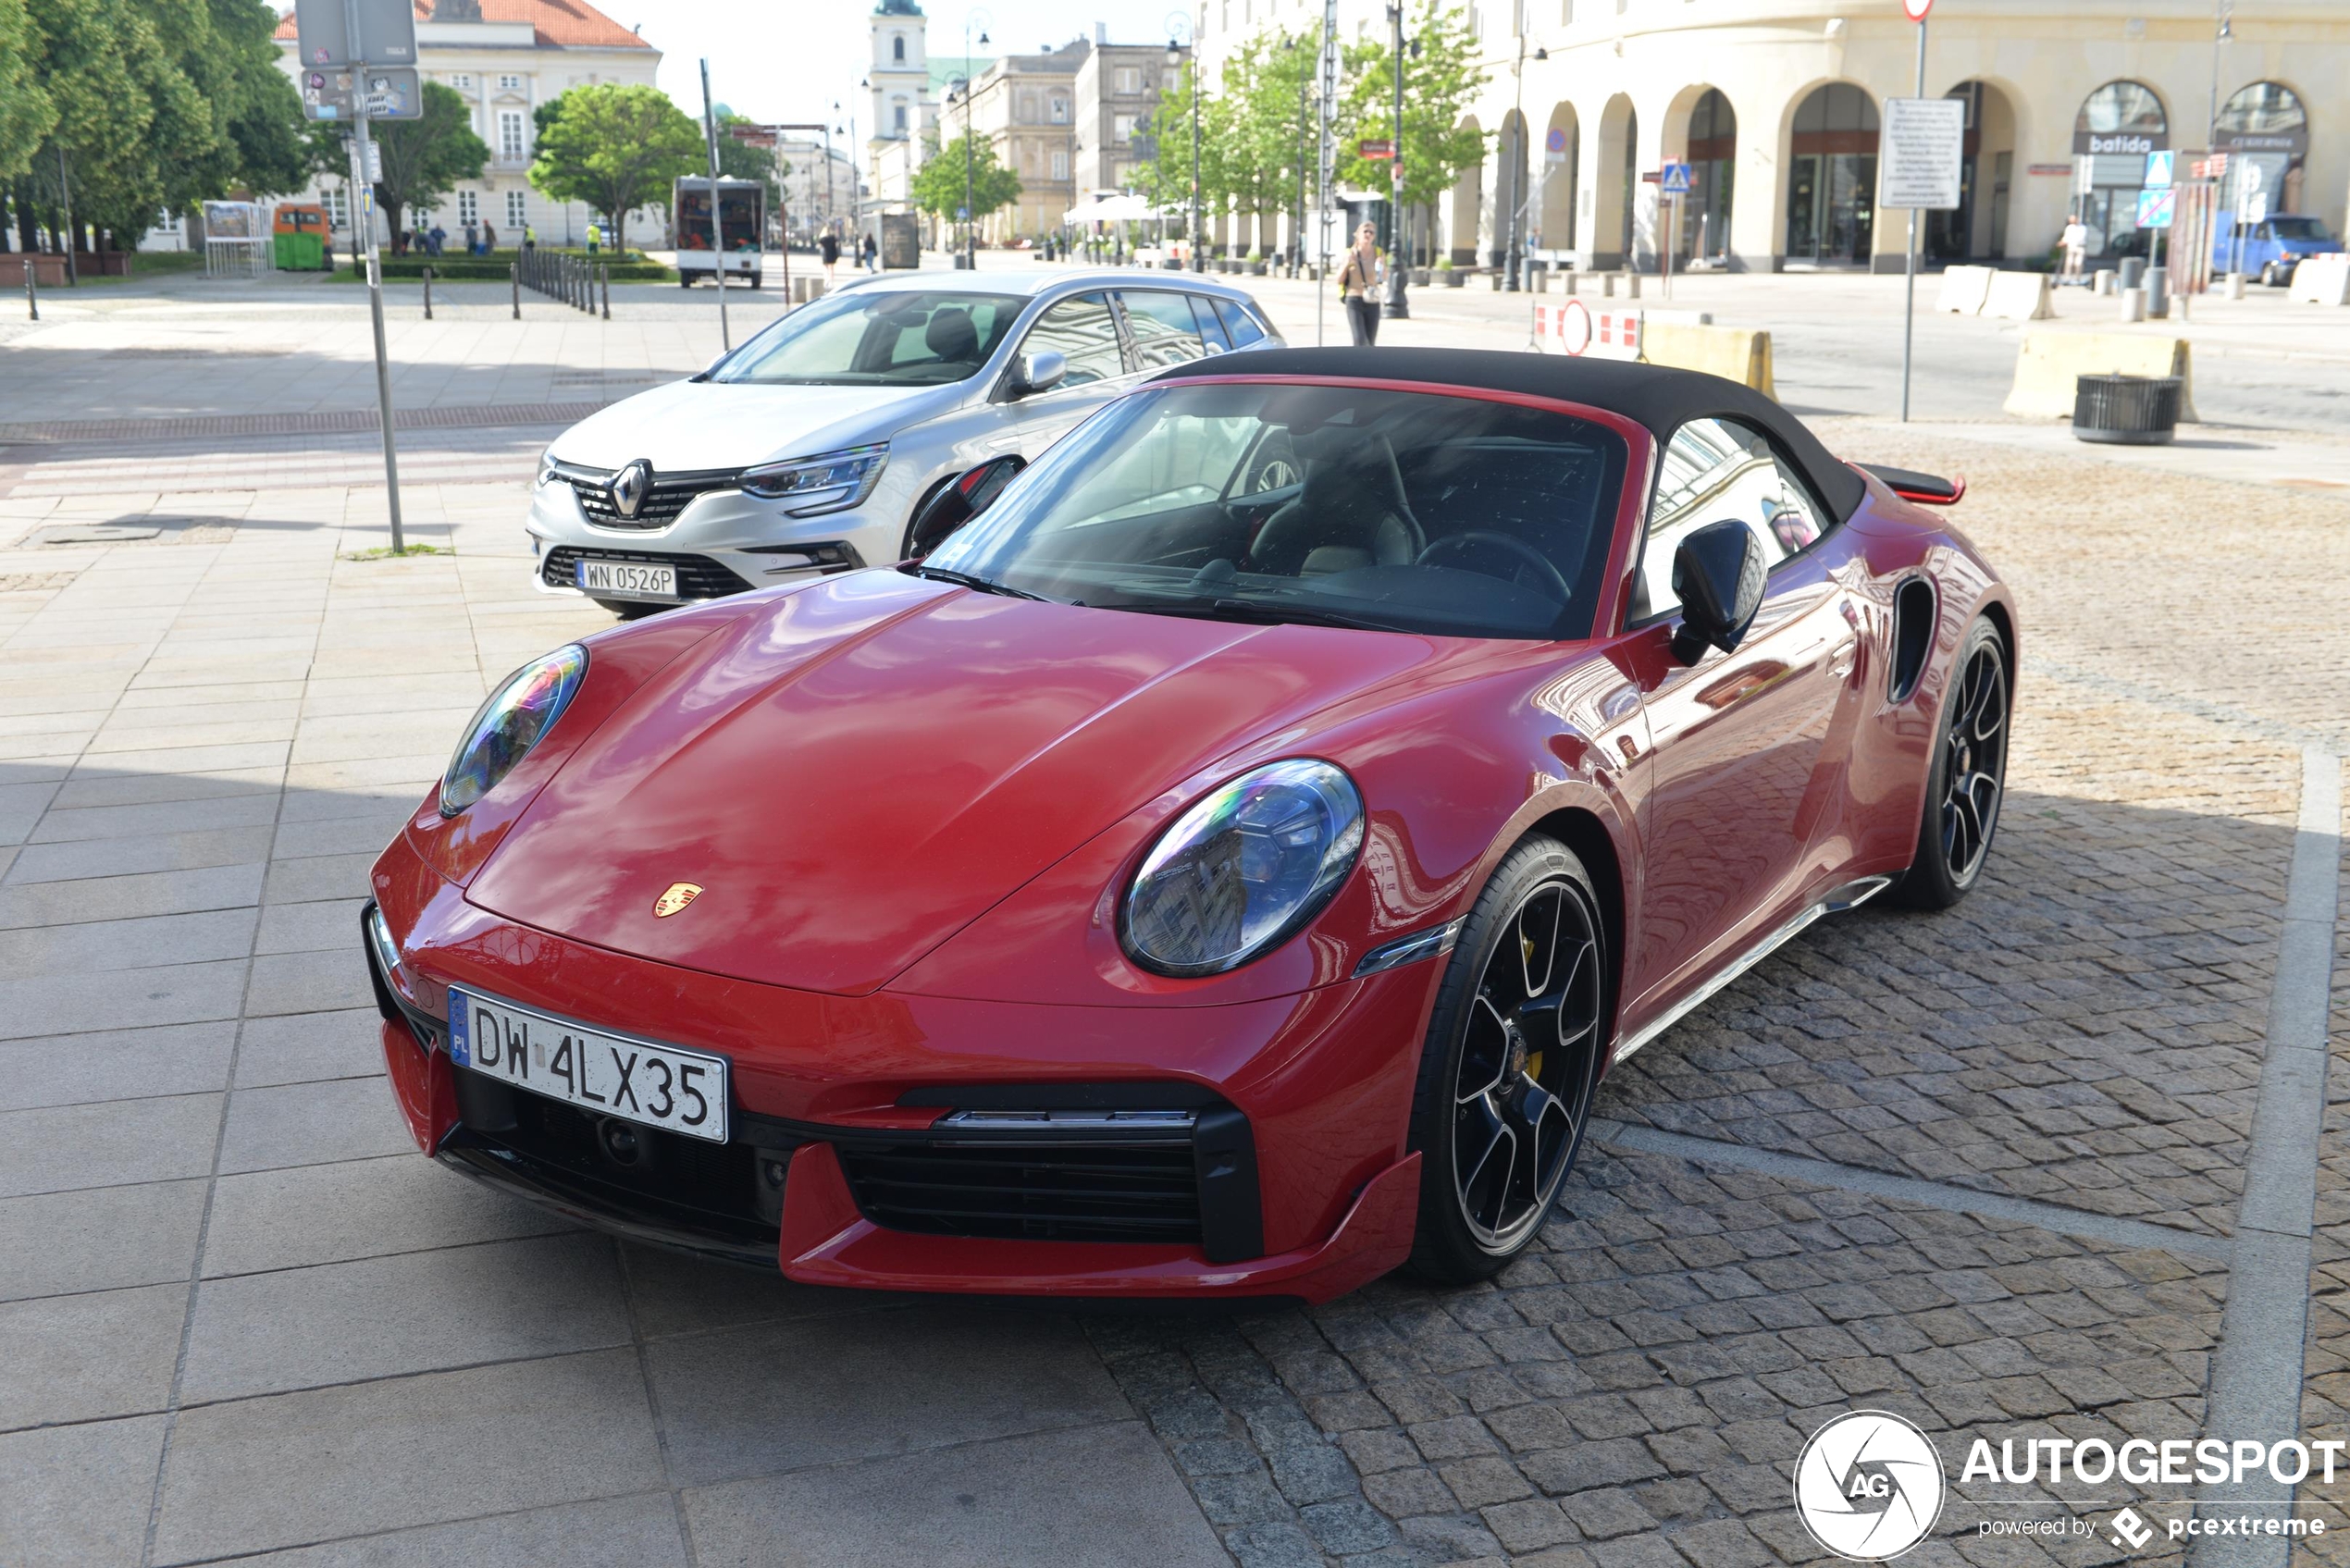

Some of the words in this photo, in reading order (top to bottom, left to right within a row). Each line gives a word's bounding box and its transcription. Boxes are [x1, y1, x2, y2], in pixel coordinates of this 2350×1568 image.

[2090, 135, 2152, 153] batida
[588, 564, 611, 587] WN
[616, 567, 672, 592] 0526P
[453, 1034, 468, 1054] PL
[475, 1006, 528, 1080] DW
[550, 1035, 708, 1126] 4LX35
